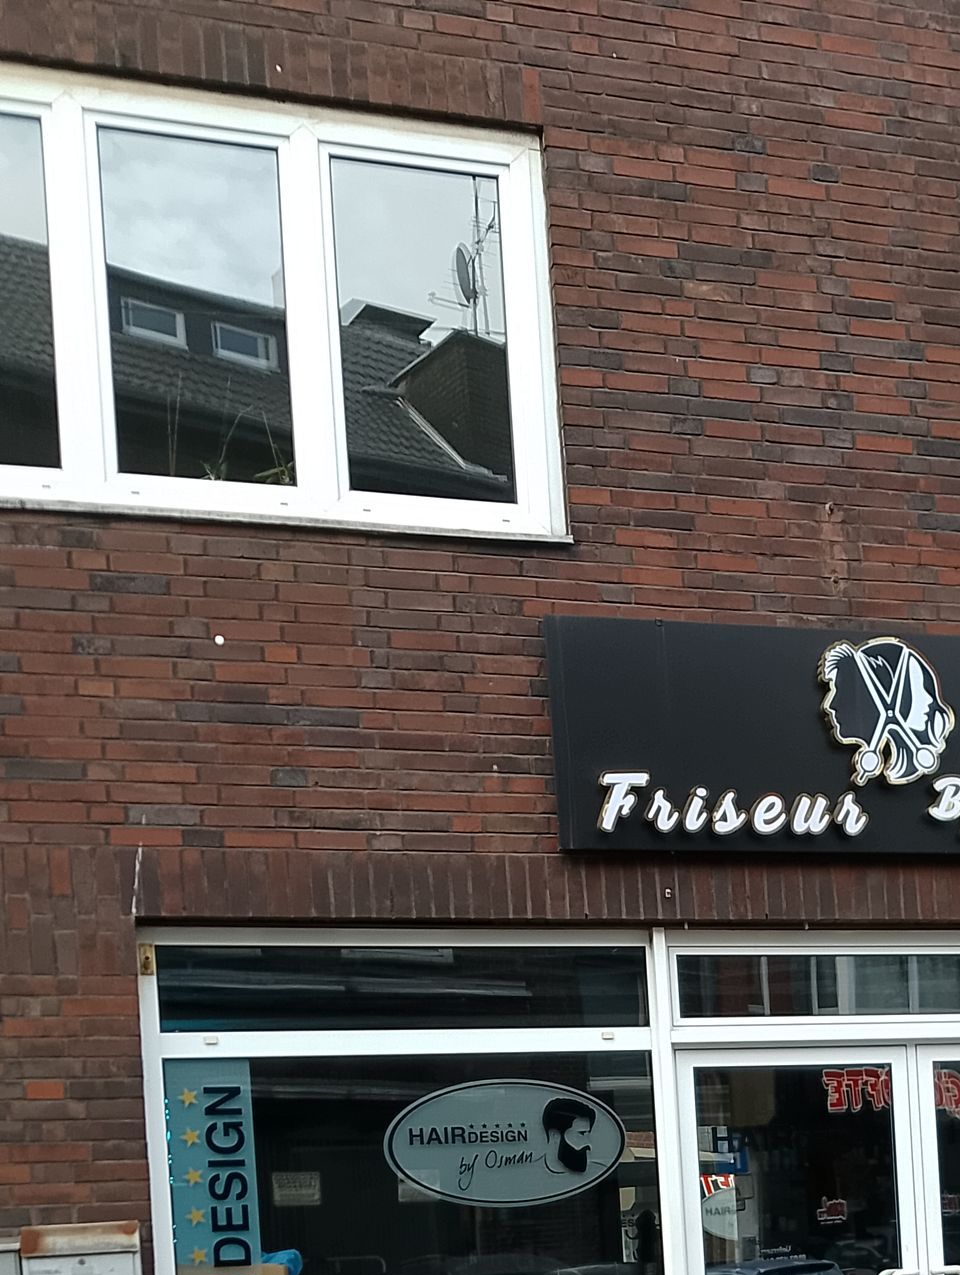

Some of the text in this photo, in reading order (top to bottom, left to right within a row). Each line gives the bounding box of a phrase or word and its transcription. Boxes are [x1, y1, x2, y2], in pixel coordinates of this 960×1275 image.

[600, 769, 870, 838] Friseur
[458, 1150, 535, 1191] by Osman
